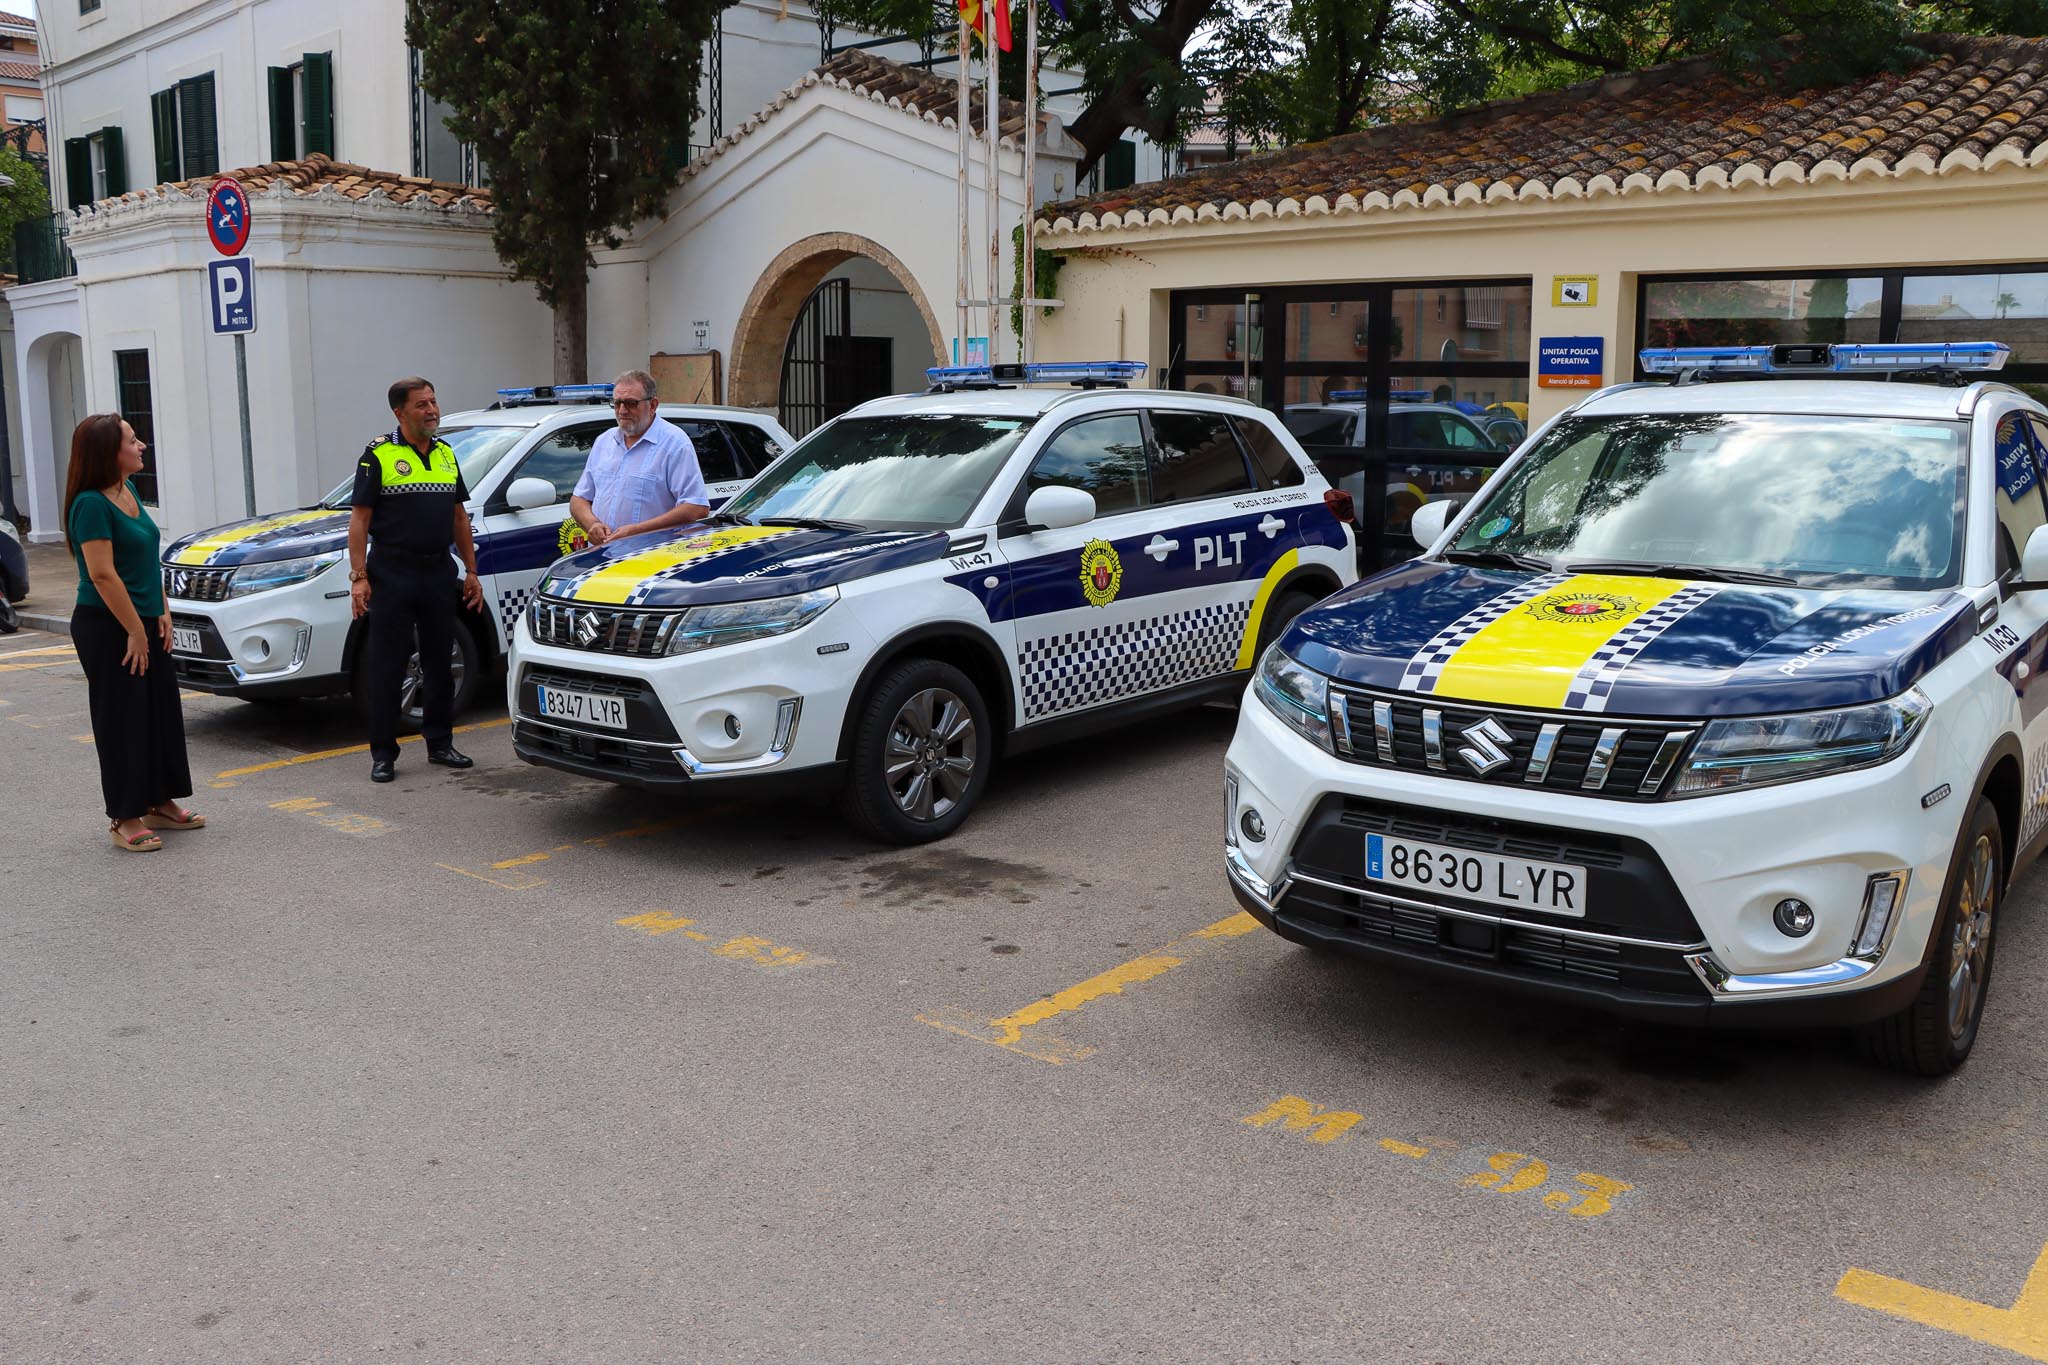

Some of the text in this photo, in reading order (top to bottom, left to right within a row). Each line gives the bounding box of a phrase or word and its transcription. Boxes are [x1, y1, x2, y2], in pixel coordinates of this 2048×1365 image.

[216, 266, 244, 326] P
[1550, 357, 1590, 365] OPERATIVA
[1568, 377, 1574, 385] al
[1232, 492, 1309, 509] POLICIA LOCAL TORRENT
[948, 552, 994, 571] M-47
[1193, 531, 1247, 571] PLT
[180, 631, 200, 650] LYR
[1777, 604, 1948, 677] POLICIA LOCAL TORRENT
[1982, 624, 2020, 655] M-30
[547, 690, 583, 718] 8347
[588, 697, 623, 725] LYR
[1371, 844, 1575, 909] E 8630 LYR
